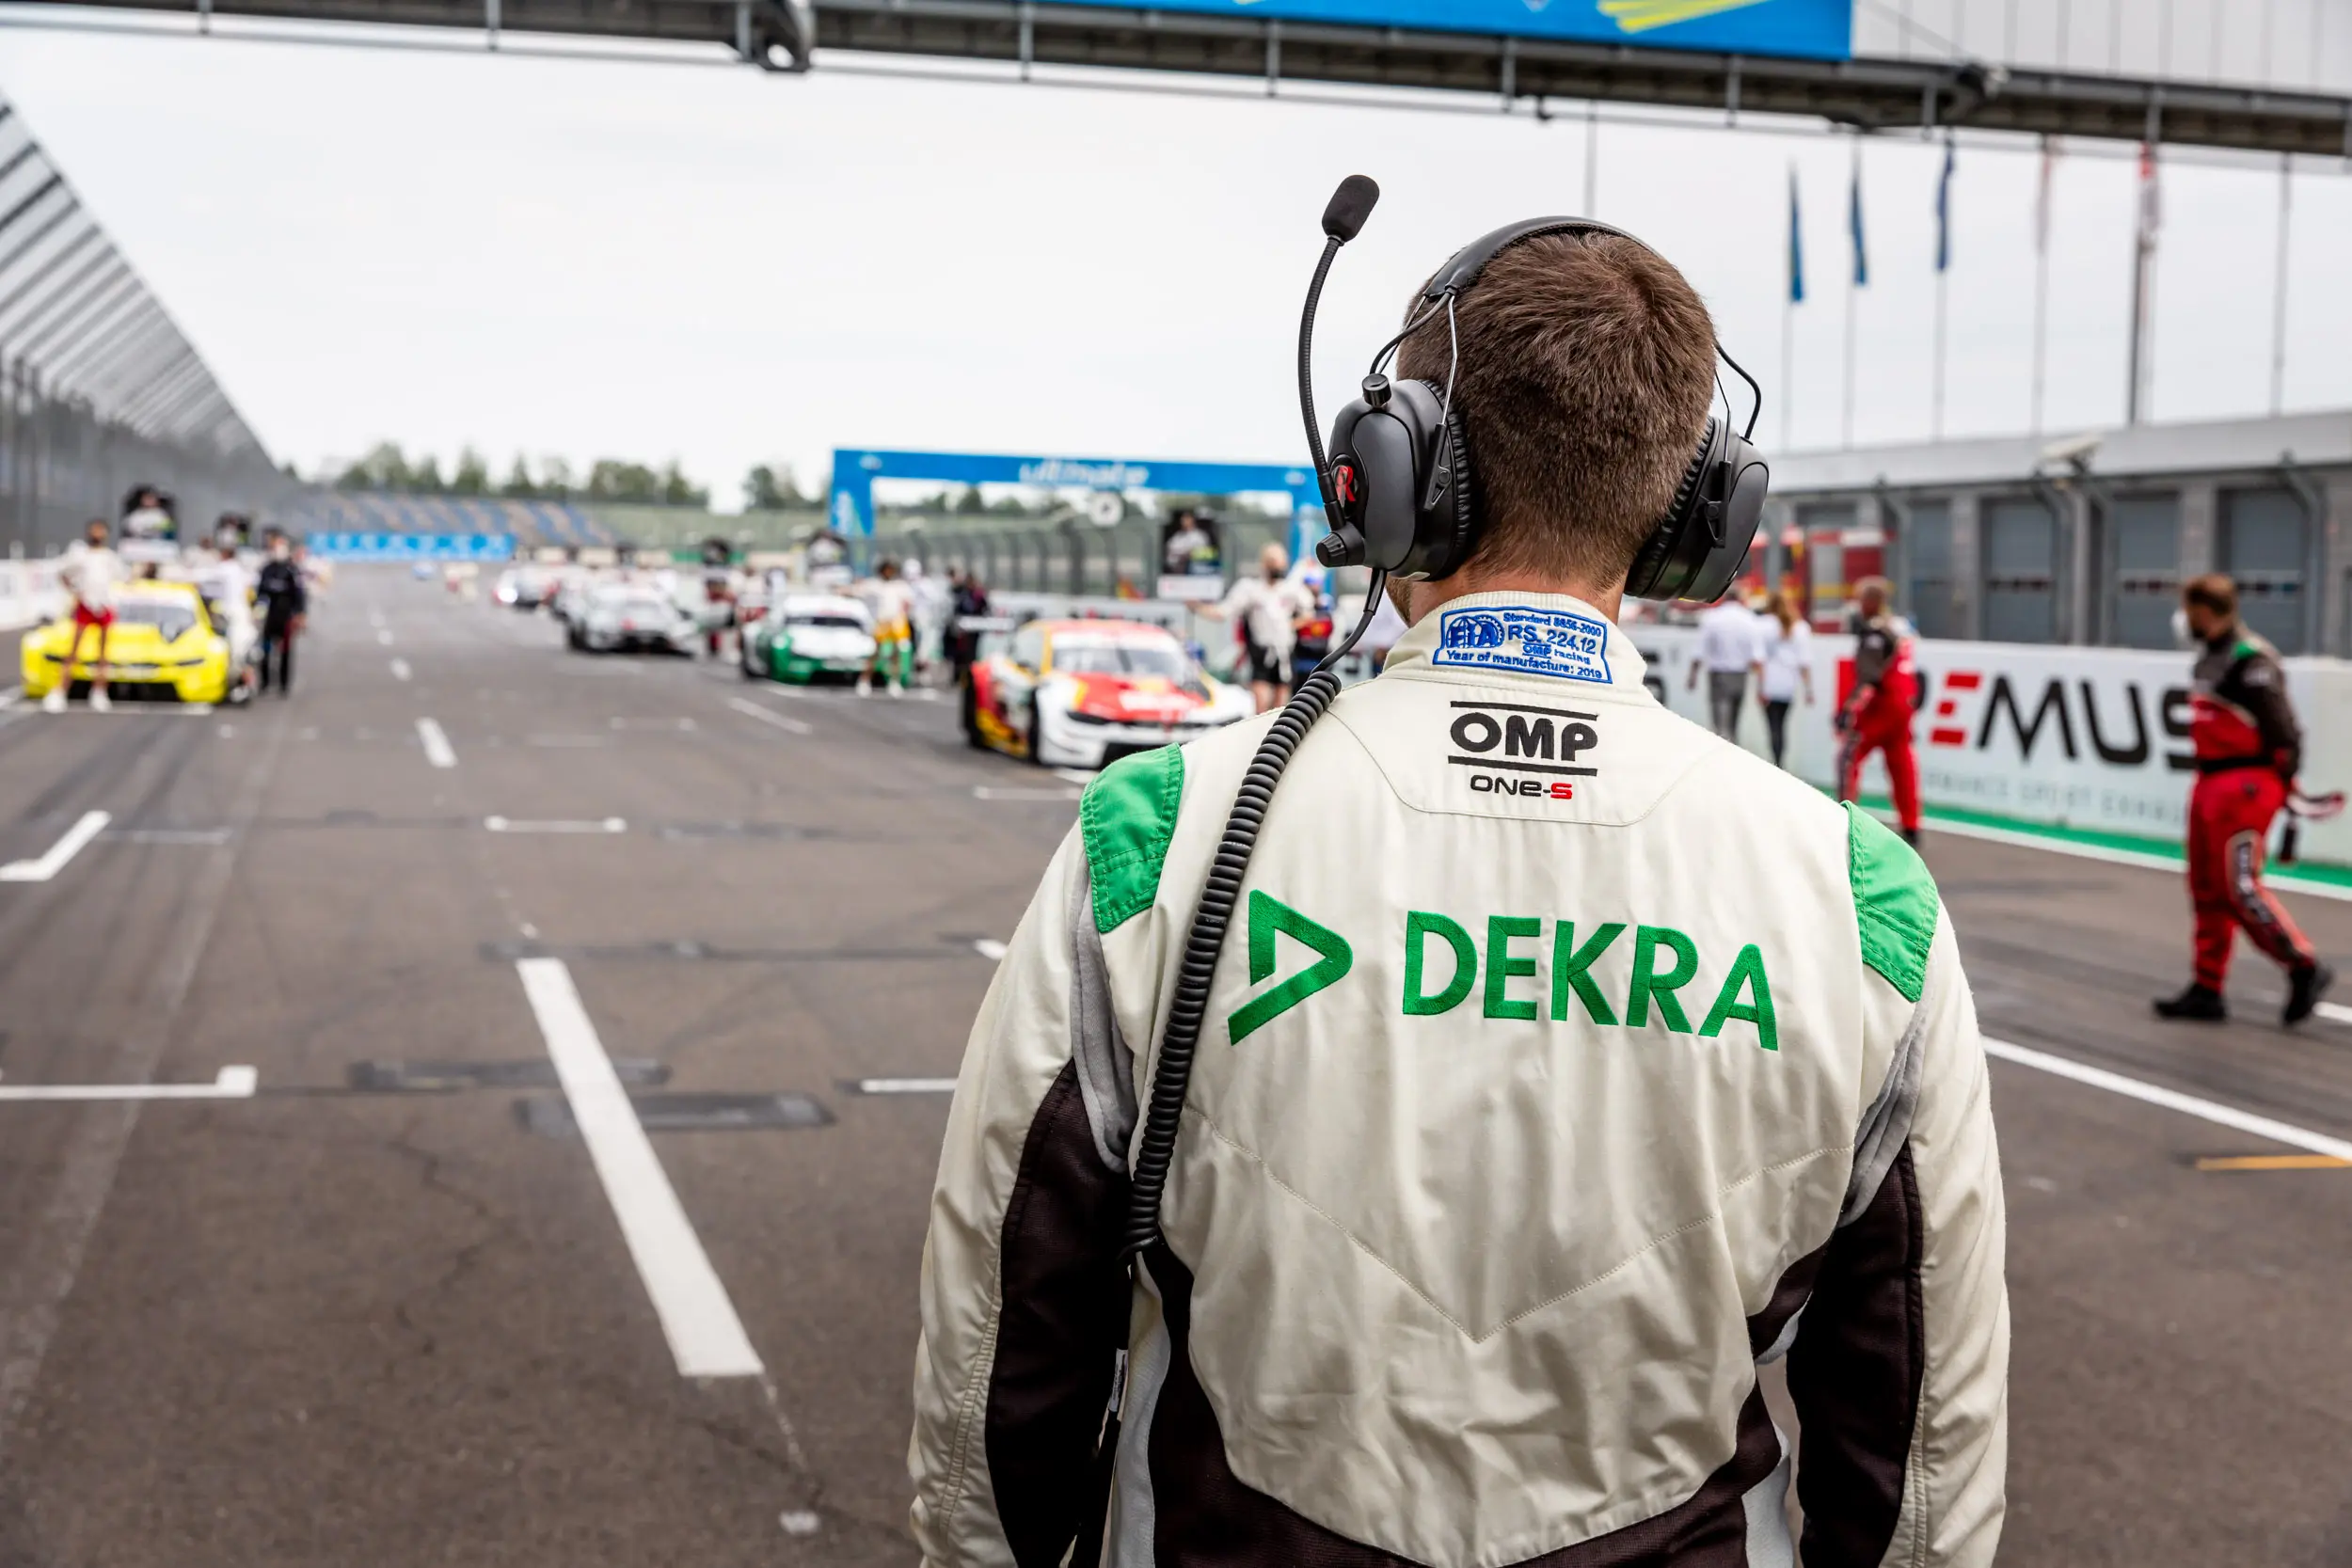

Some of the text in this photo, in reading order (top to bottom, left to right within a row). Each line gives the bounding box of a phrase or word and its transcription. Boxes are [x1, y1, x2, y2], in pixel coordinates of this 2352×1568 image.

[1448, 620, 1502, 648] FIA
[1503, 612, 1602, 637] Standard 8856-2000
[1508, 625, 1597, 655] RS. 224.12
[1522, 643, 1591, 665] OMP racing
[1446, 649, 1602, 678] Year of manufacture: 2019
[1450, 712, 1598, 762] OMP
[1402, 911, 1778, 1051] DEKRA
